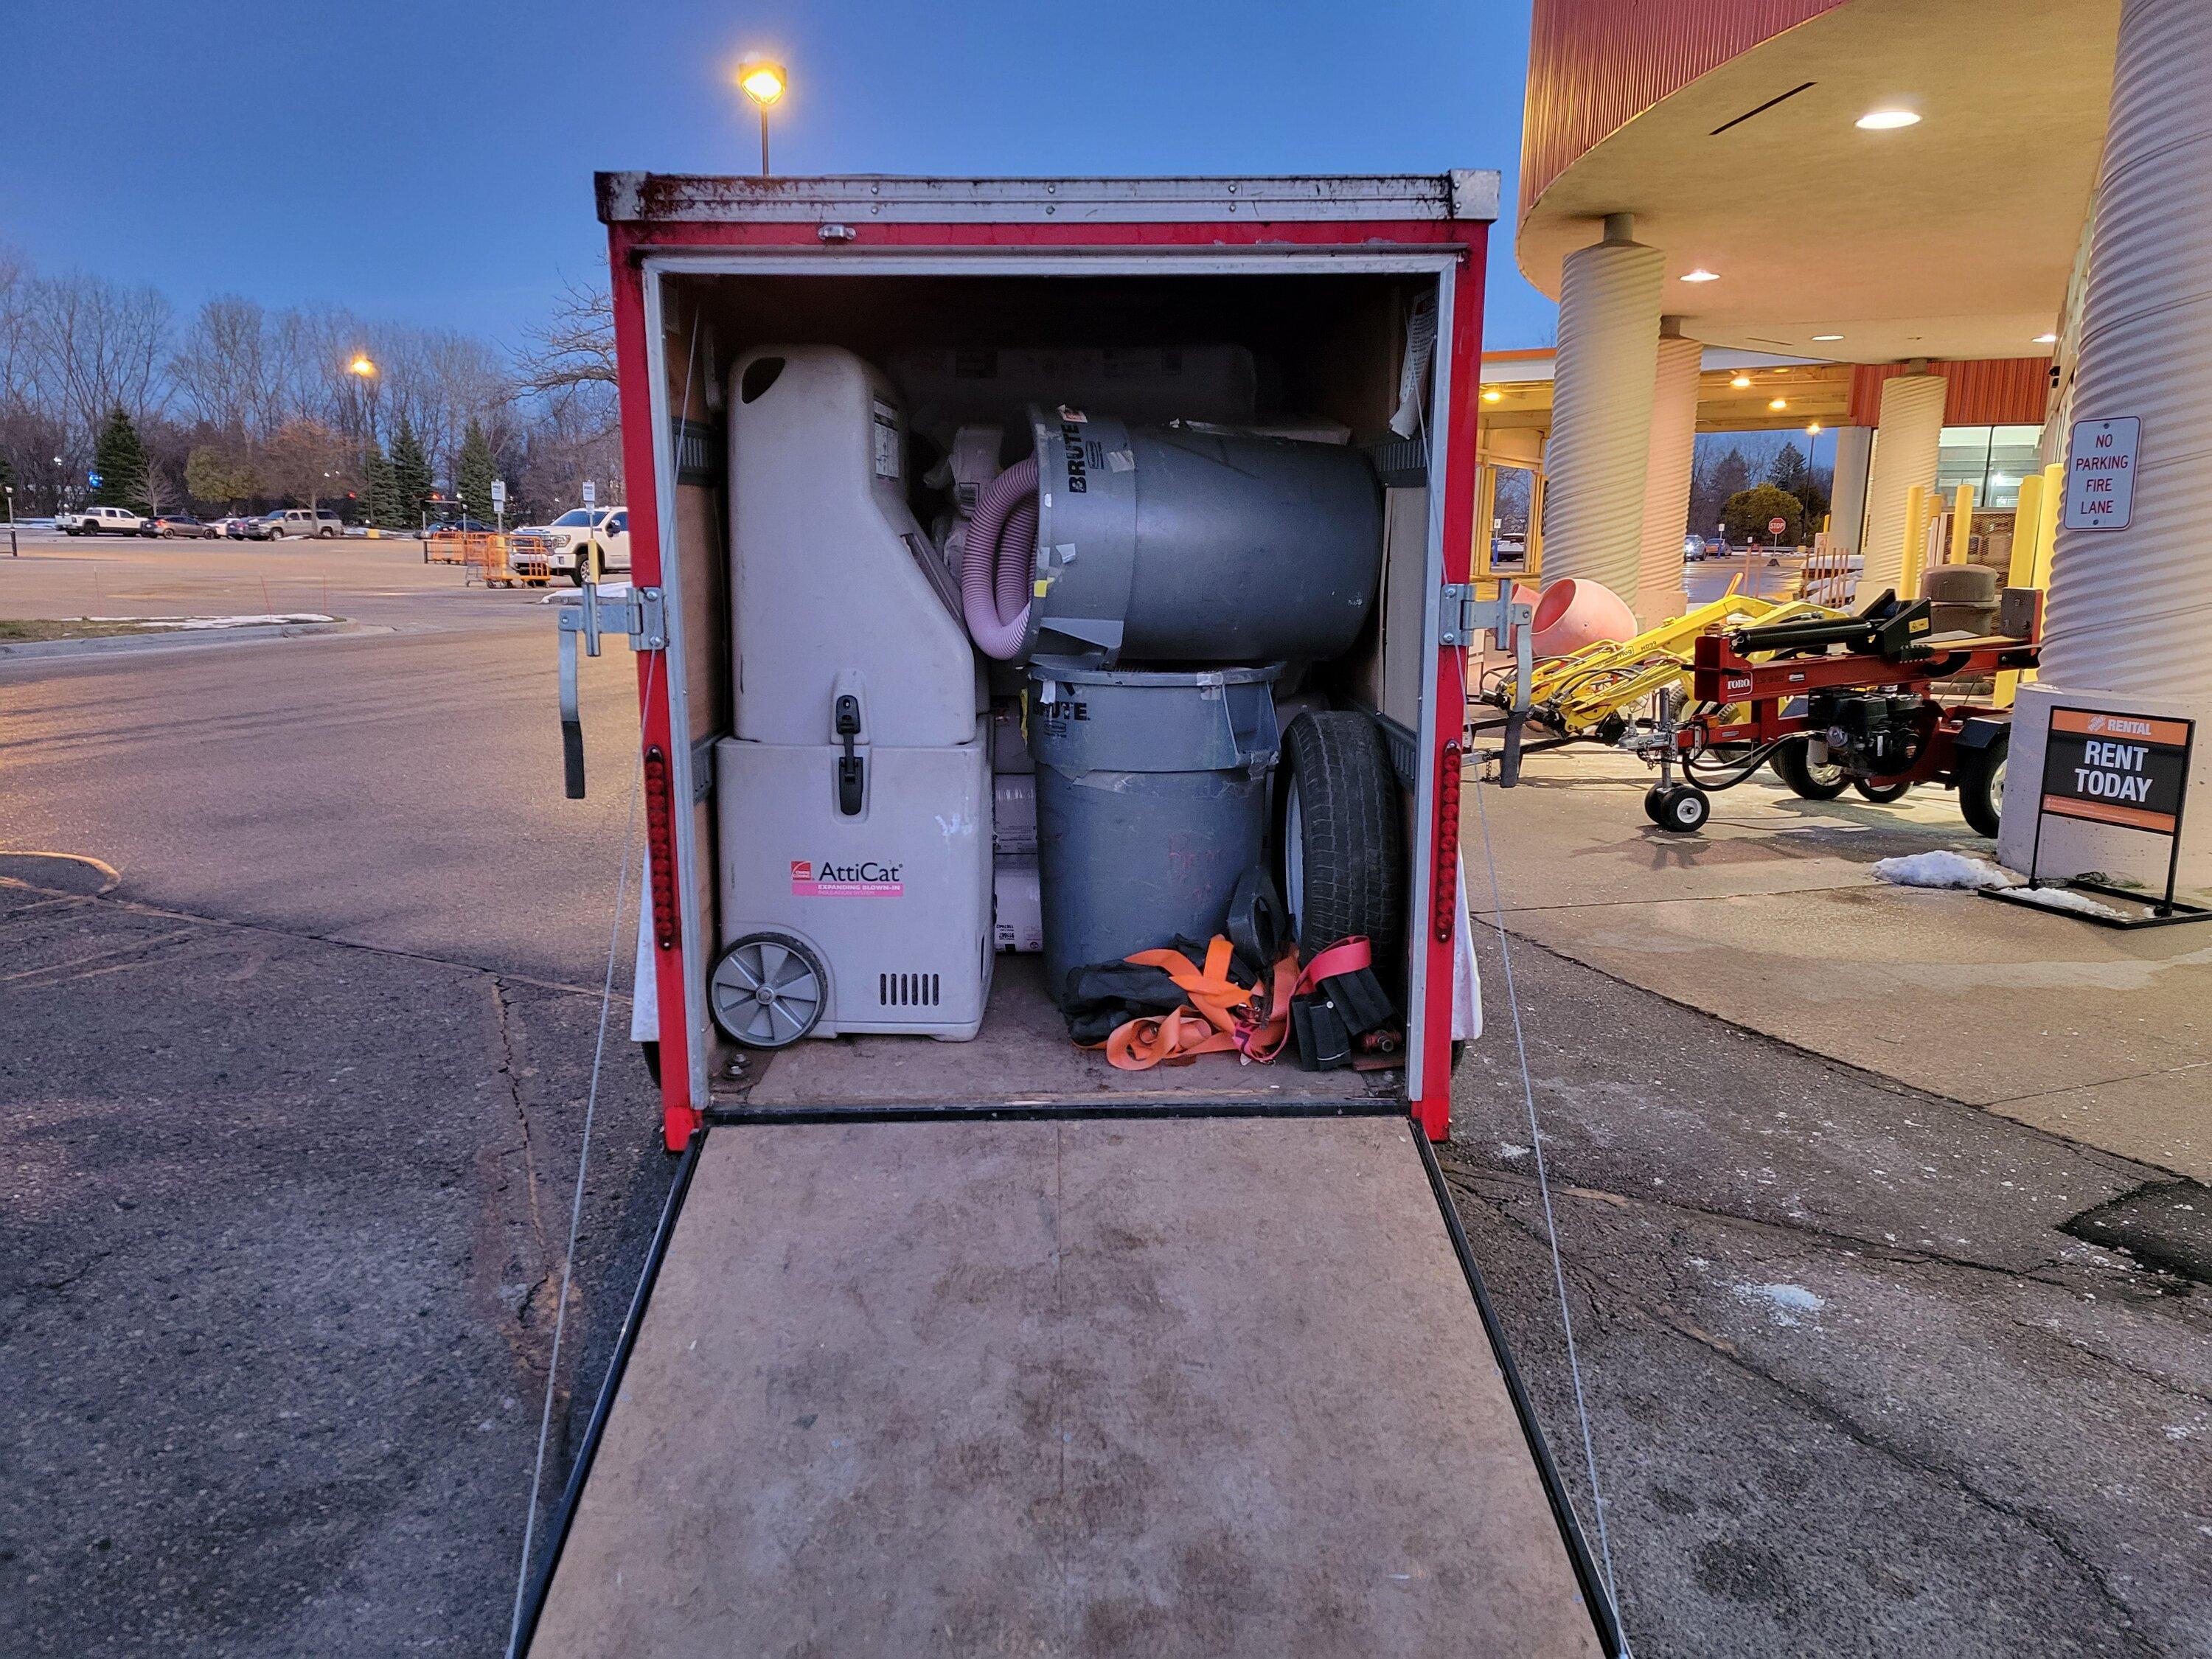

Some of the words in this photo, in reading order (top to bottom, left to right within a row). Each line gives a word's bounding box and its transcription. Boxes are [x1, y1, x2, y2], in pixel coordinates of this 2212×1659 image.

[2096, 434, 2113, 448] NO
[1061, 424, 1087, 493] BRUTE
[2076, 455, 2129, 471] PARKING
[2086, 479, 2113, 493] FIRE
[2081, 500, 2114, 514] LANE
[1641, 641, 1657, 651] HD99
[1727, 678, 1750, 689] TORO
[2107, 719, 2152, 736] RENTAL
[2084, 740, 2149, 771] RENT
[2074, 768, 2153, 802] TODAY
[819, 862, 900, 882] AttiCat
